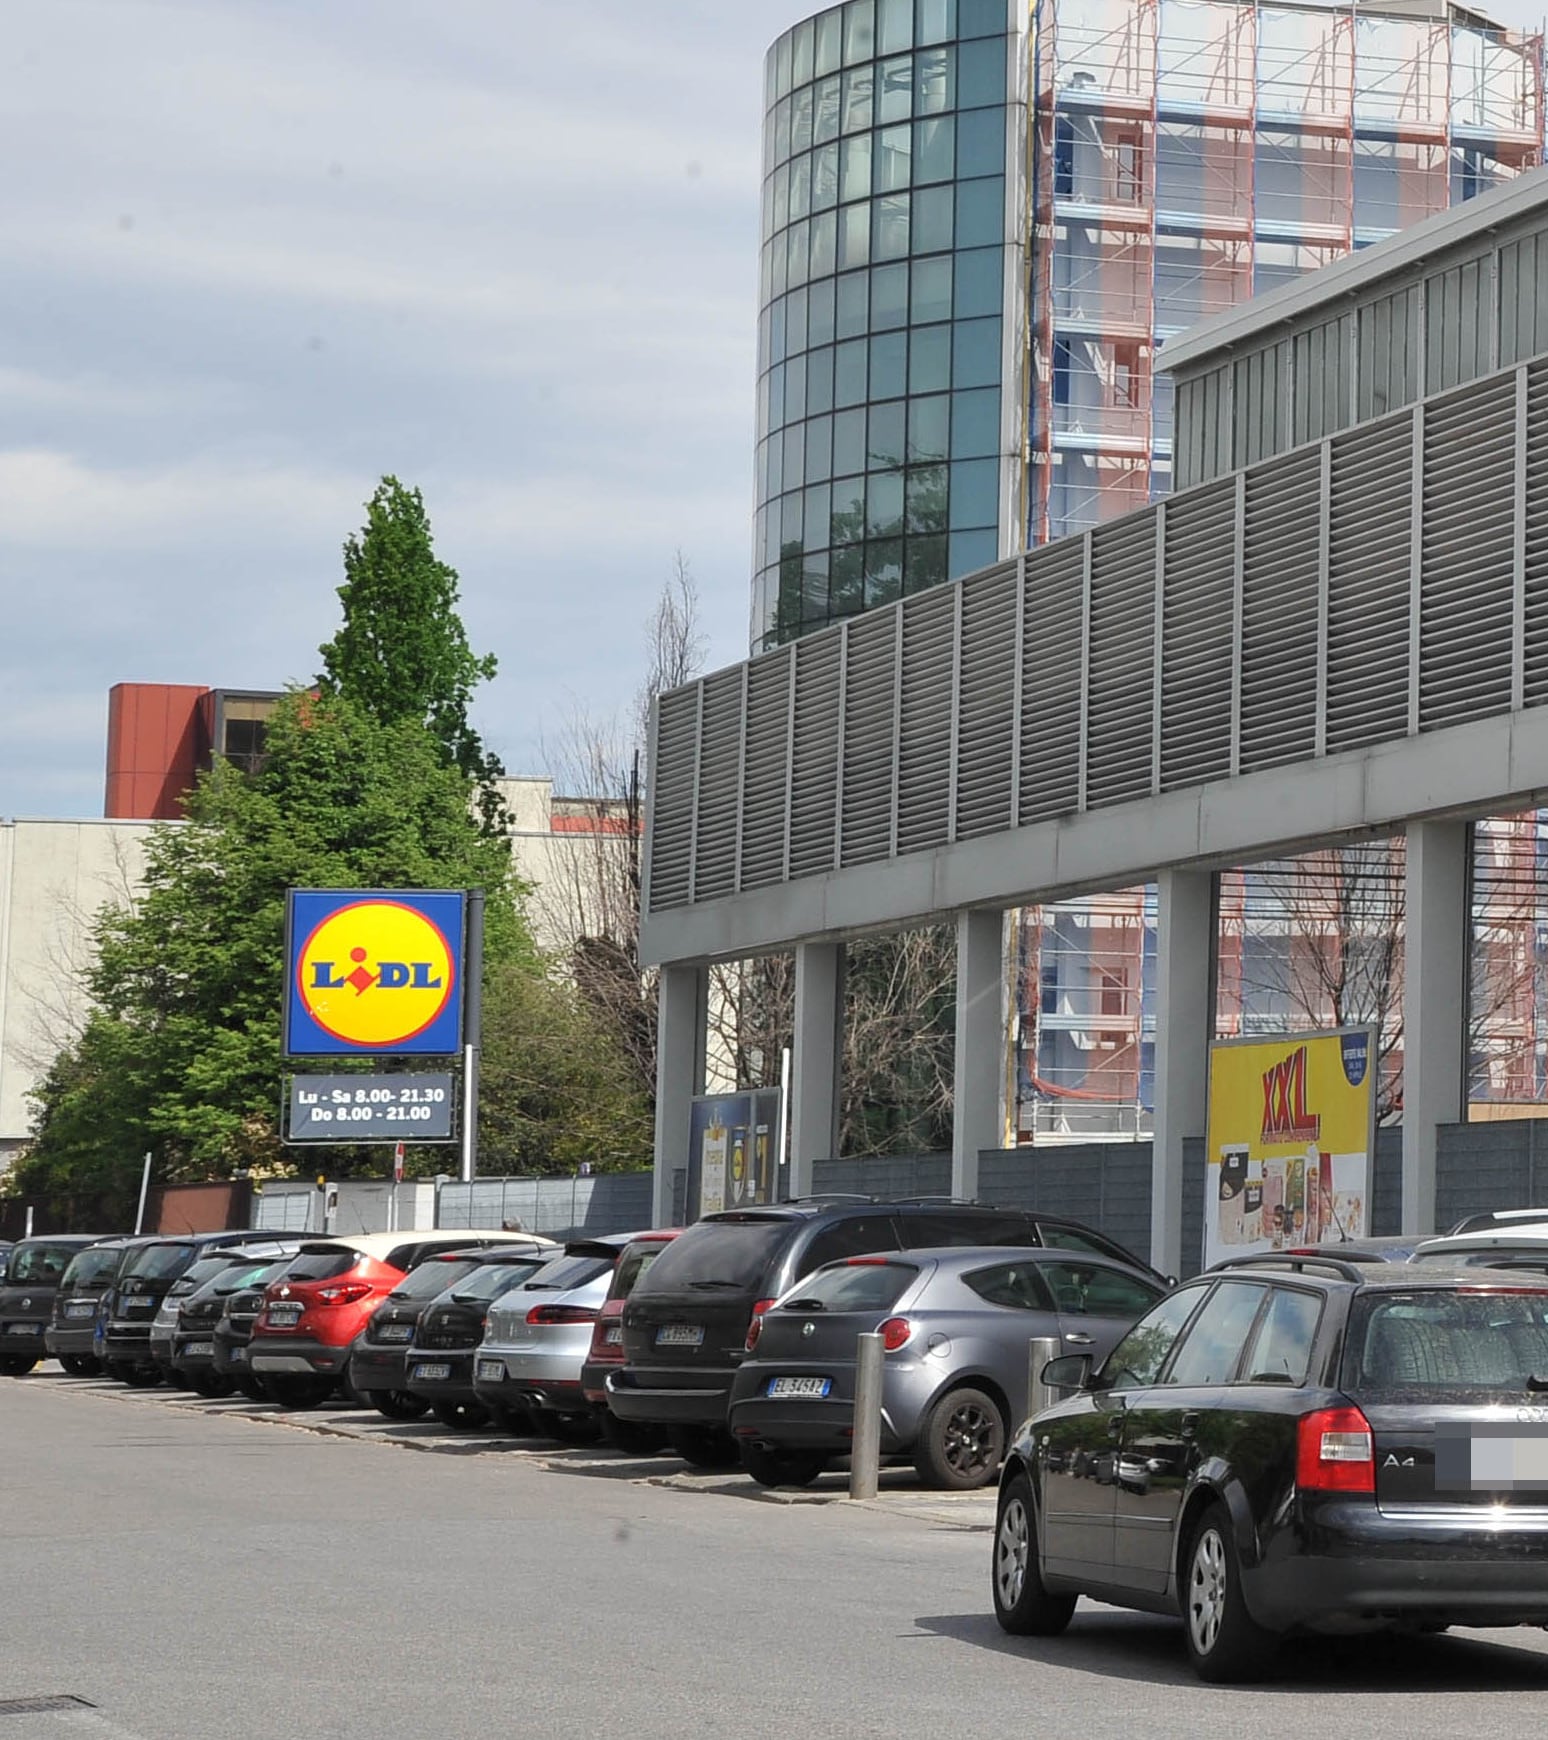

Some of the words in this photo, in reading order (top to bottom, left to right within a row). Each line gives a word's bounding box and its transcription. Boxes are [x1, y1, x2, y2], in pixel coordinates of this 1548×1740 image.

[299, 1090, 318, 1104] Lu
[332, 1089, 351, 1103] Sa
[400, 1088, 444, 1102] 21.30
[1262, 1046, 1320, 1136] XXL
[311, 1108, 333, 1121] Do
[336, 1107, 372, 1121] 8.00
[386, 1106, 431, 1120] 21.00
[1383, 1453, 1415, 1467] A4
